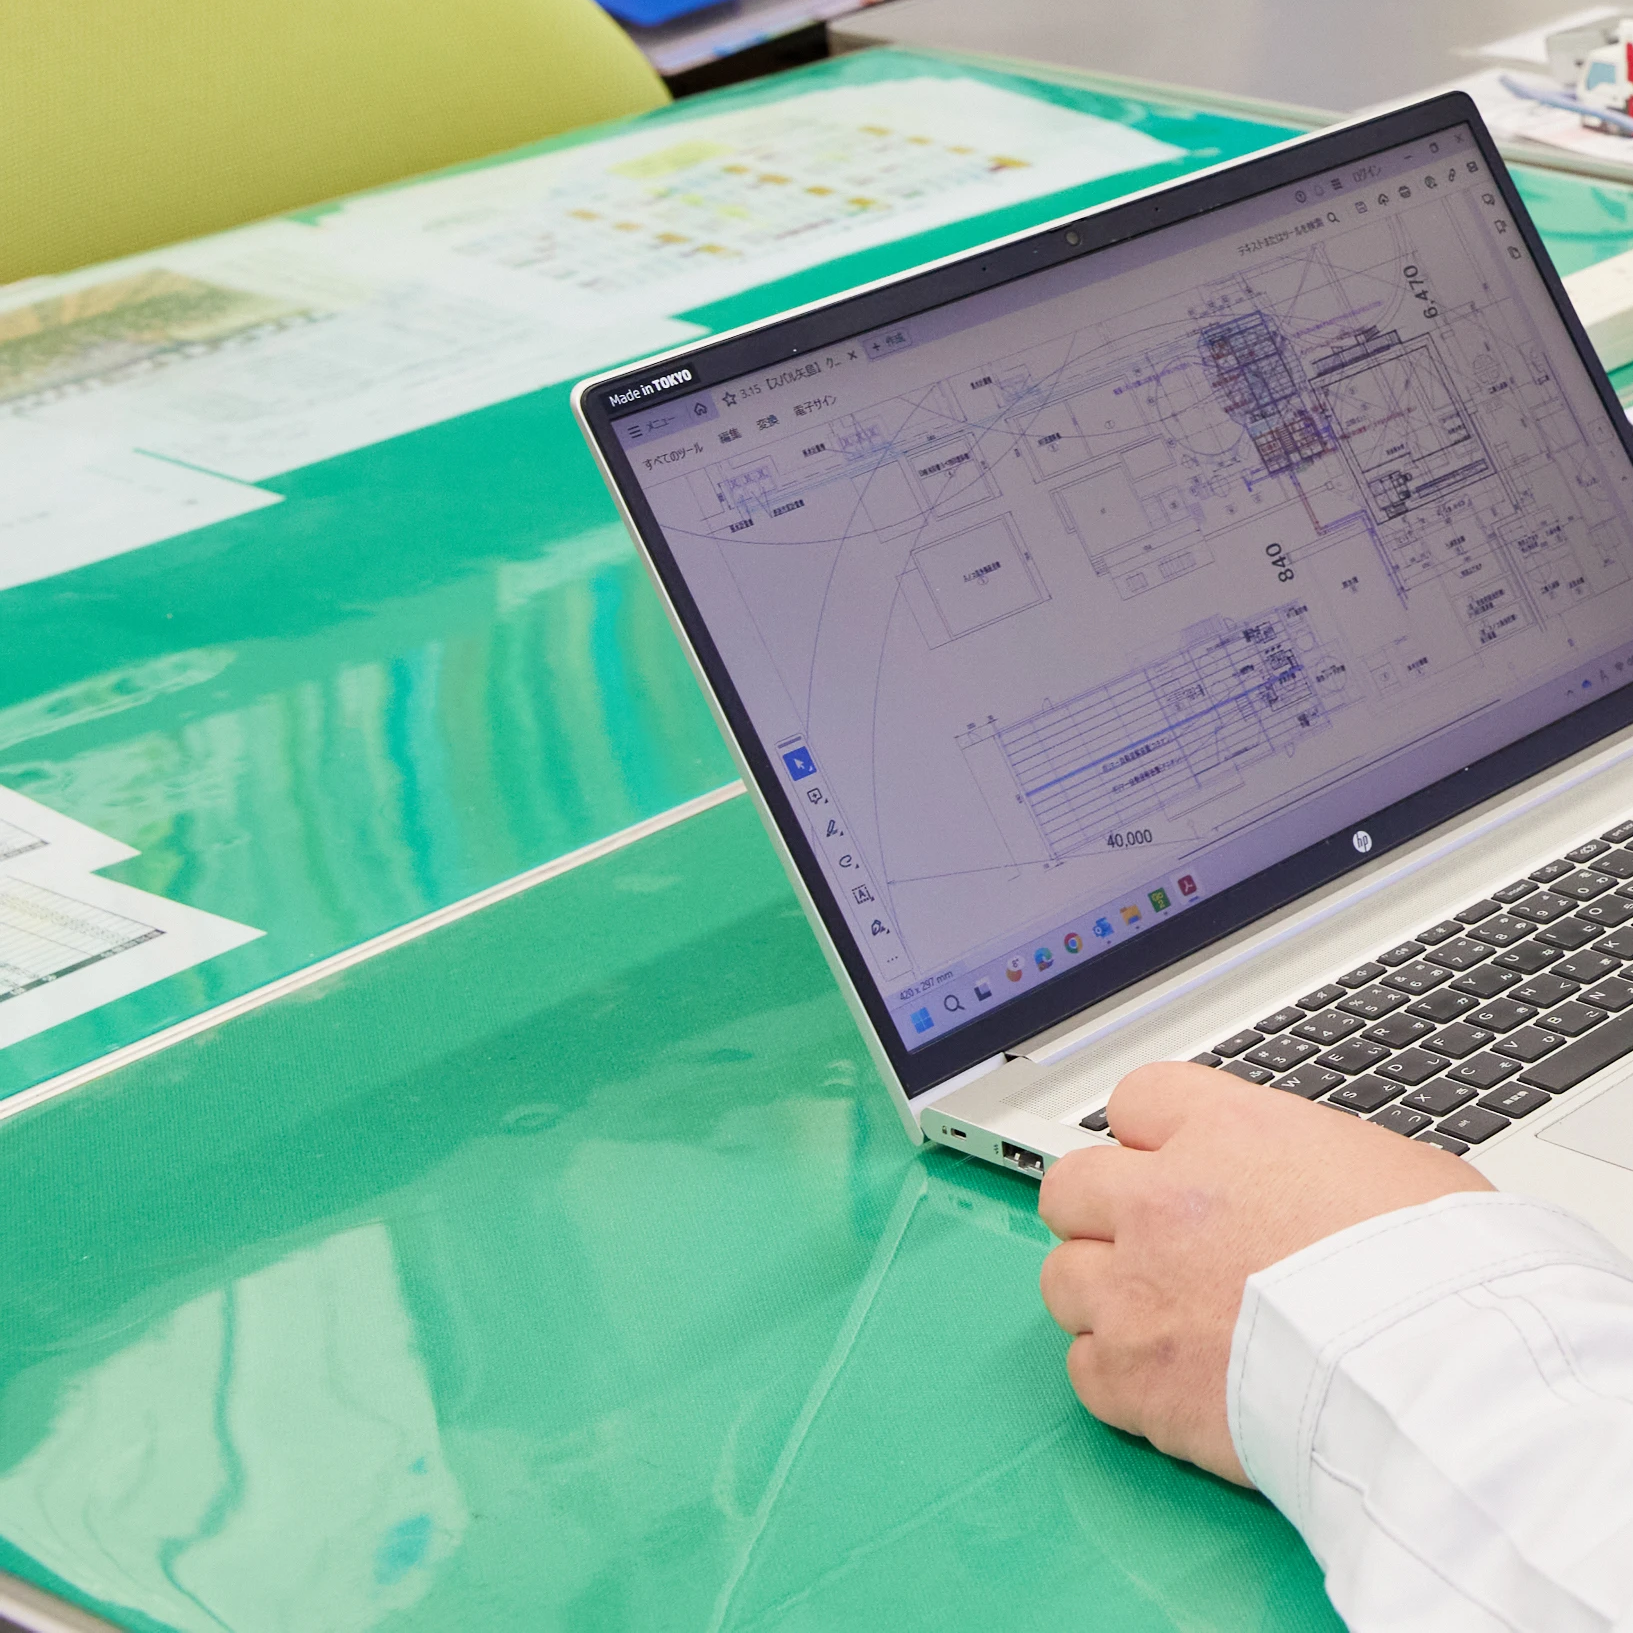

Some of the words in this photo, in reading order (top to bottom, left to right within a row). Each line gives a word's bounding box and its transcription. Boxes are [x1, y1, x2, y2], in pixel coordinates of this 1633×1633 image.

[608, 388, 640, 407] Made
[640, 384, 654, 396] in
[651, 369, 692, 392] TOKYO
[740, 384, 762, 399] 3.15
[646, 416, 675, 430] メニュー
[642, 443, 703, 470] すべてのツール
[717, 428, 742, 444] 編集
[756, 415, 780, 431] 変換
[793, 395, 837, 417] 電子サイン
[1265, 542, 1294, 583] 840
[1106, 829, 1153, 848] 40,000
[1353, 830, 1372, 853] hp
[1603, 940, 1619, 948] K
[900, 987, 915, 1000] 420
[920, 977, 935, 991] 297
[936, 971, 953, 983] mm
[1374, 1028, 1390, 1036] R
[1328, 1053, 1344, 1061] E
[1282, 1077, 1300, 1088] W
[1414, 1094, 1431, 1102] X
